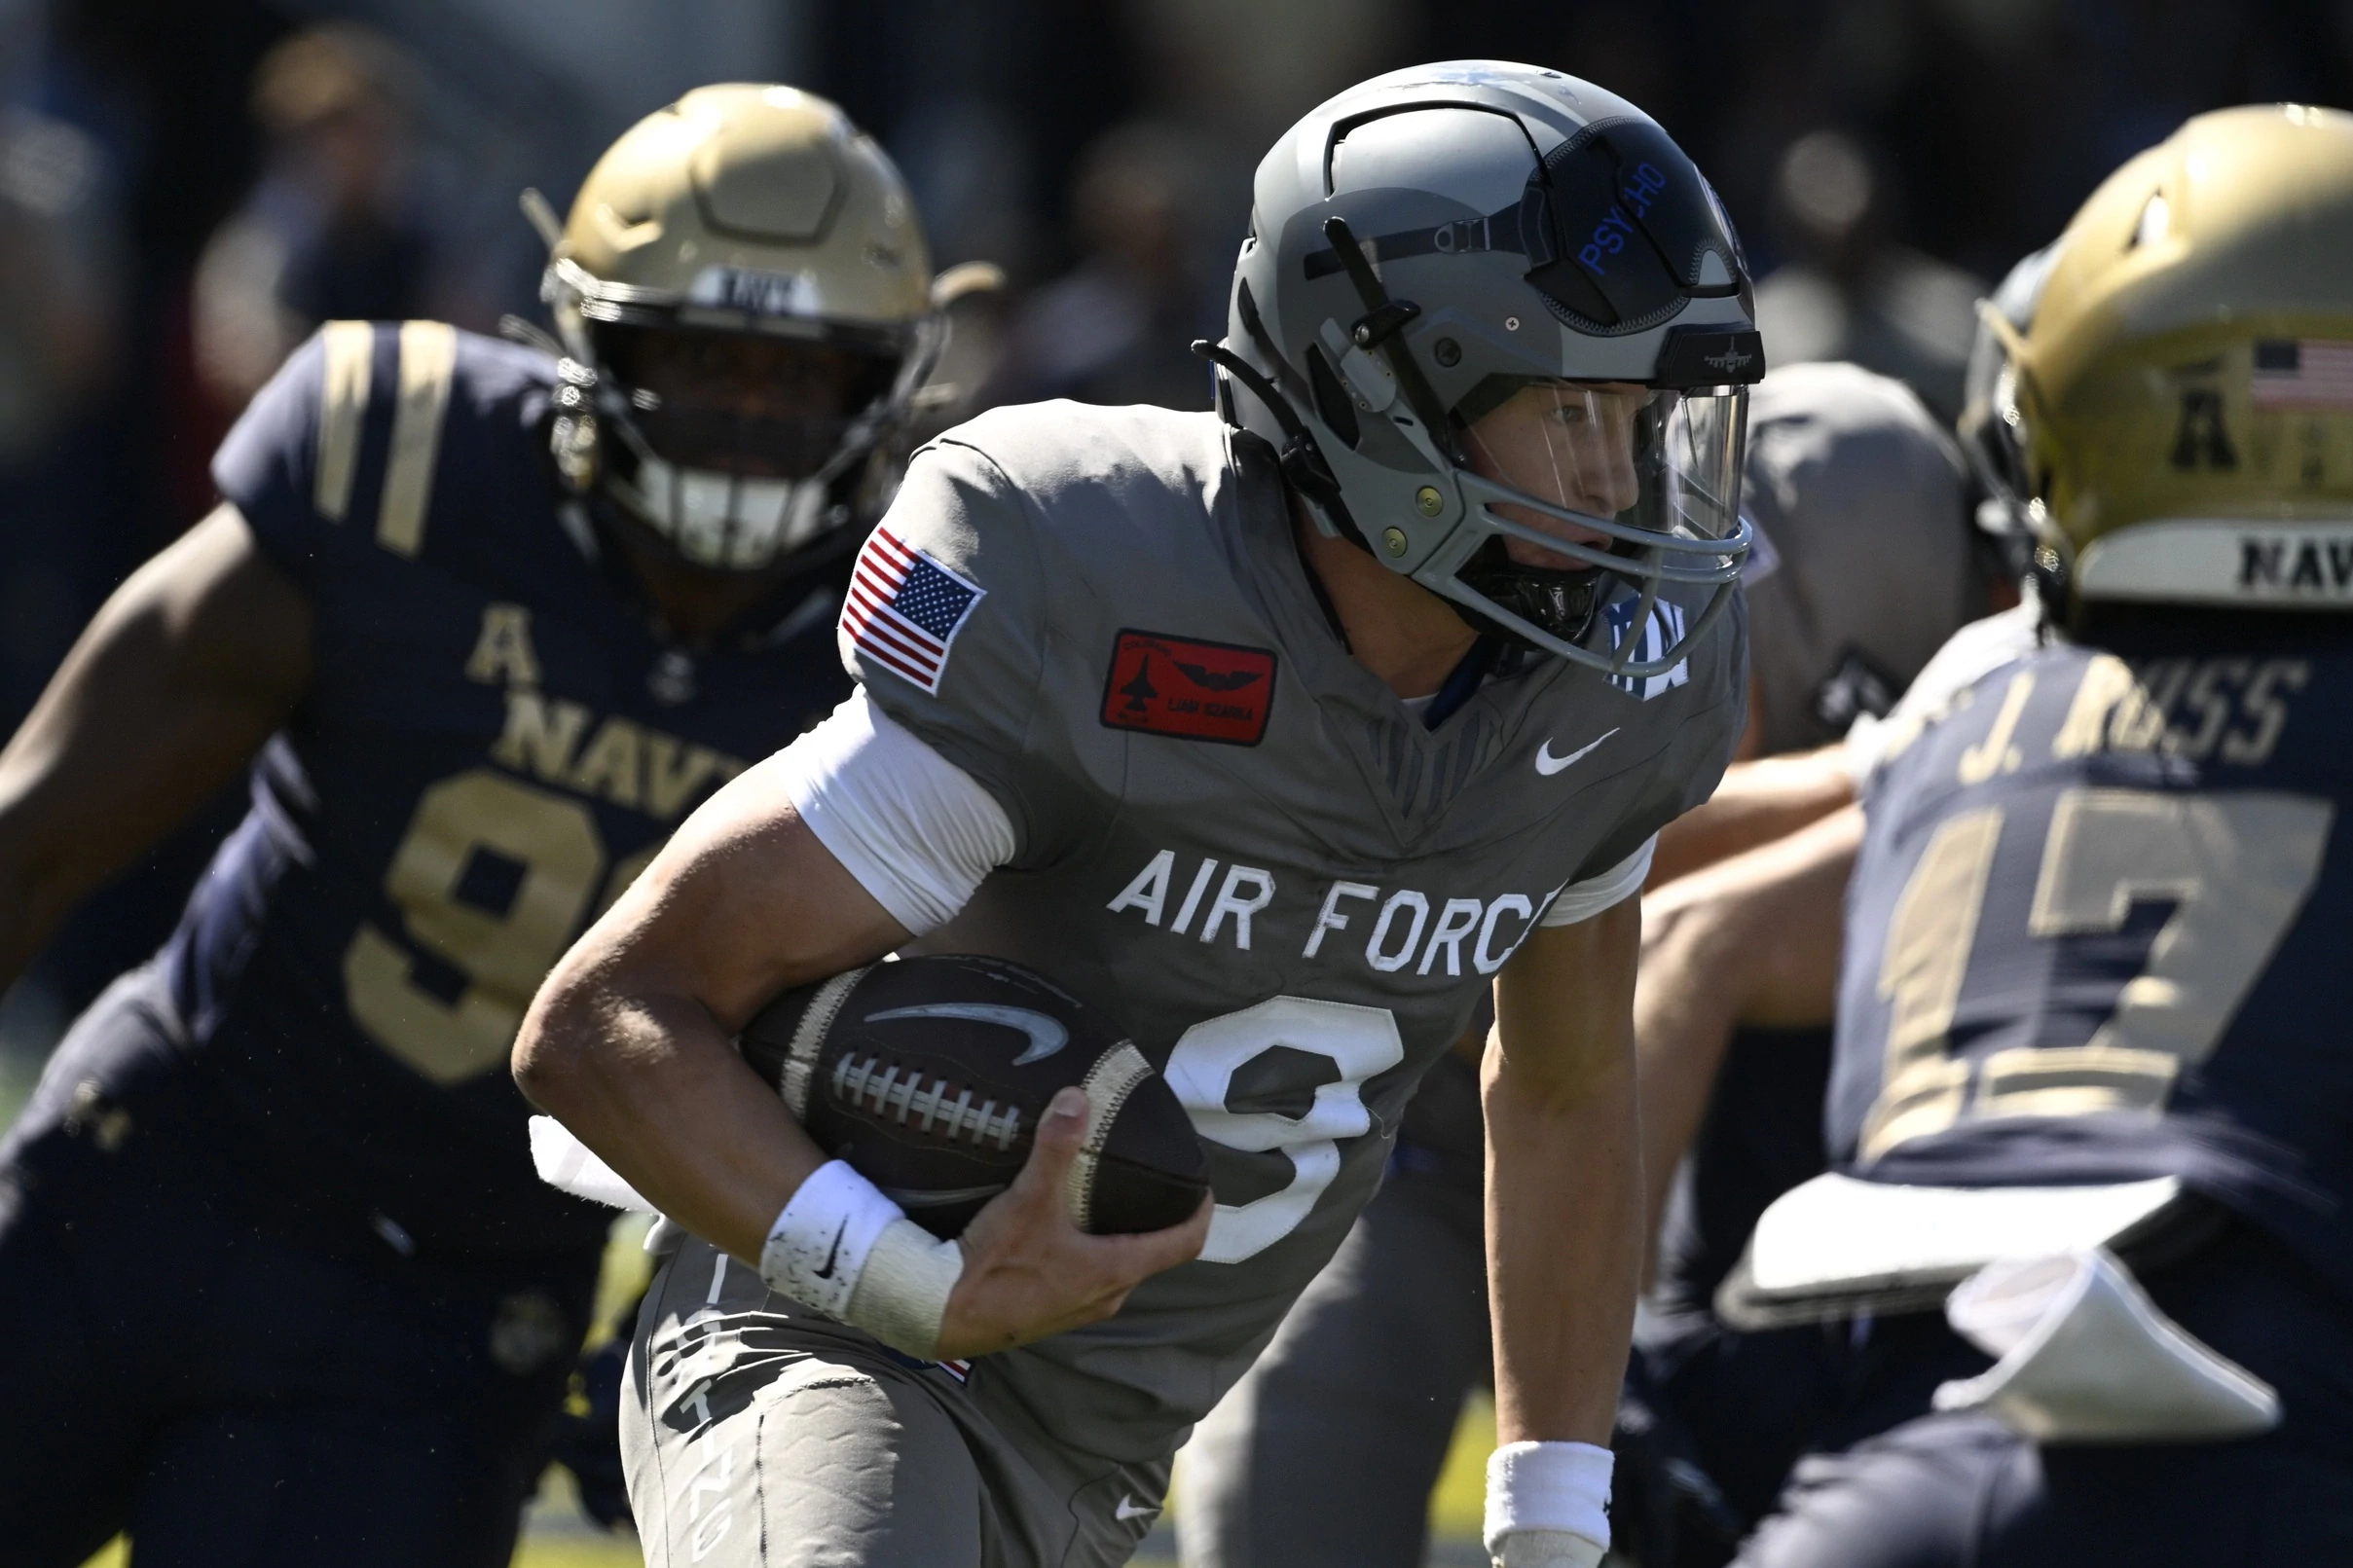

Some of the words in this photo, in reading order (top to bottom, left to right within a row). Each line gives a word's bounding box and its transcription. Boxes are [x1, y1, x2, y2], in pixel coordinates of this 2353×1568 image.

[492, 695, 752, 818] NAV
[341, 769, 670, 1084] 9
[1107, 849, 1276, 950] AIR
[1857, 786, 2331, 1160] 17
